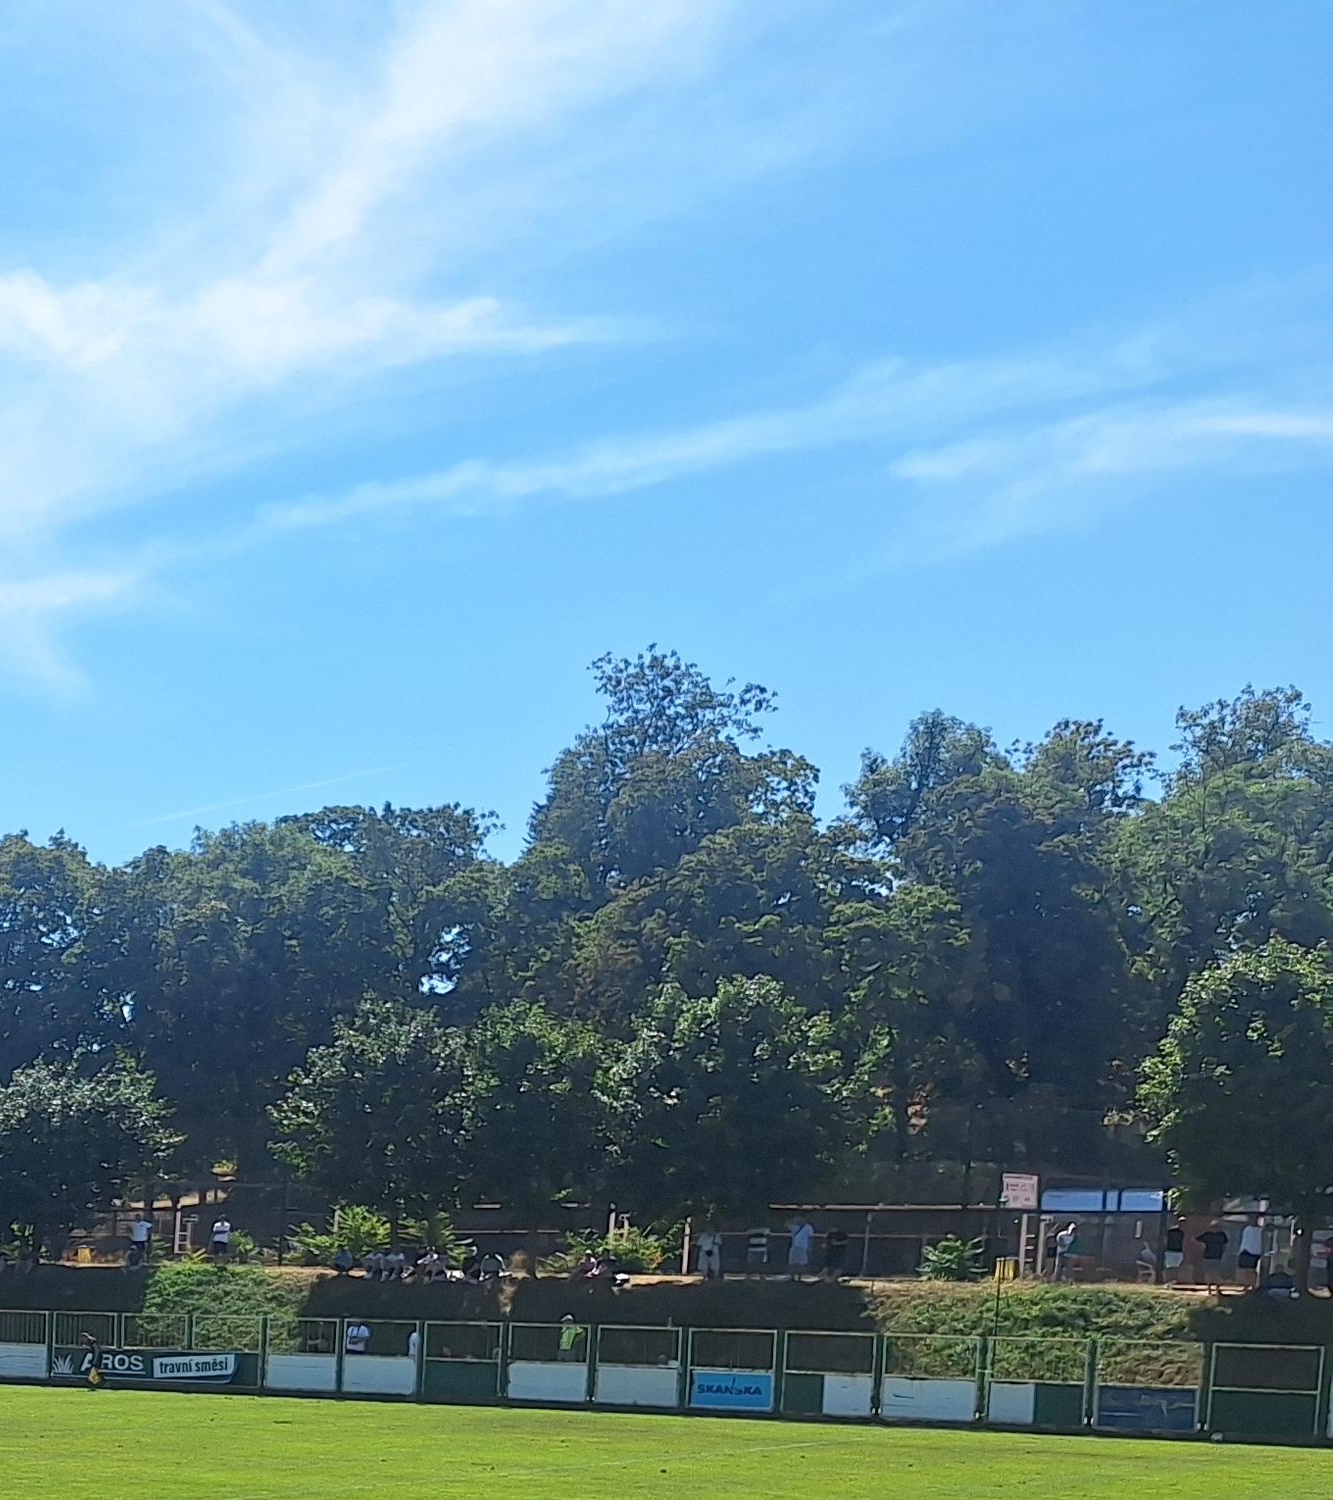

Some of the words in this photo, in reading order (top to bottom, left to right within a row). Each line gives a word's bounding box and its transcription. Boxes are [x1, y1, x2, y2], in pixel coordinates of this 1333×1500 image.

[159, 1359, 193, 1374] travní
[195, 1357, 229, 1372] směsi
[697, 1384, 762, 1396] SKANSKA
